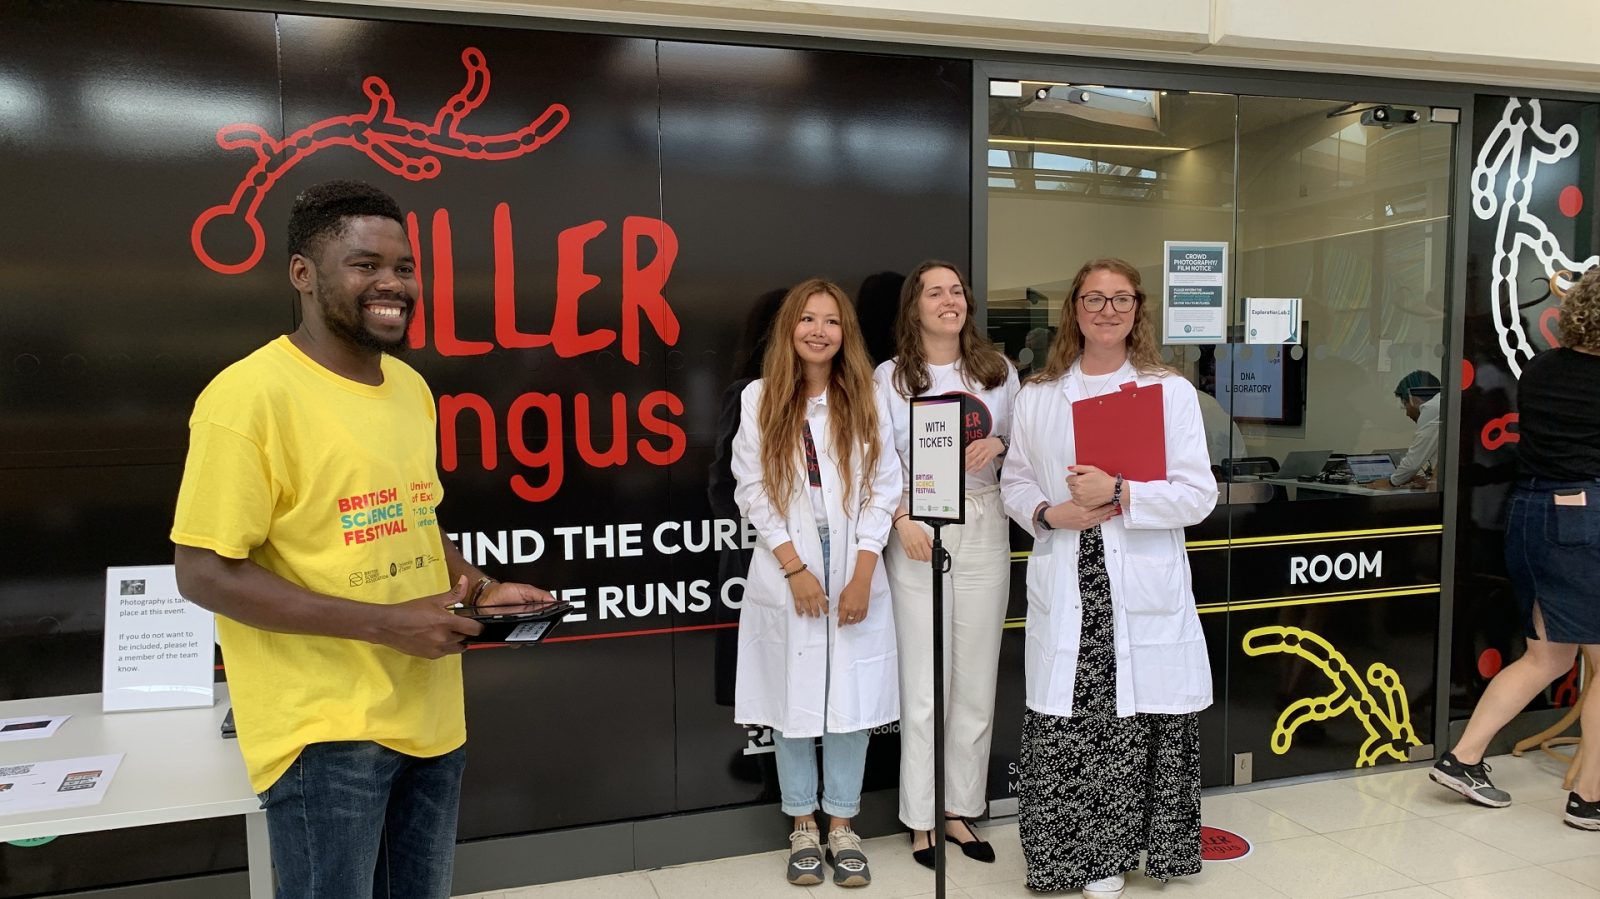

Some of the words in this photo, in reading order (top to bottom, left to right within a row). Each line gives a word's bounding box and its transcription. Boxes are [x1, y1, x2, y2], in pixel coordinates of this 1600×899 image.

[406, 201, 681, 366] ILLER
[1225, 383, 1272, 394] LBORATORY
[1240, 372, 1256, 381] DNA
[925, 420, 946, 433] WITH
[438, 389, 687, 502] ngus
[919, 436, 953, 448] TICKETS
[337, 487, 398, 513] BRITISH
[340, 502, 404, 530] SCIENCE
[343, 519, 408, 546] FESTIVAL
[553, 522, 644, 561] THE
[652, 518, 758, 556] CURE
[1290, 550, 1383, 585] ROOM
[120, 598, 166, 607] Photography
[598, 578, 712, 620] RUNS
[120, 610, 140, 618] place
[129, 643, 162, 651] included,
[164, 642, 187, 650] please
